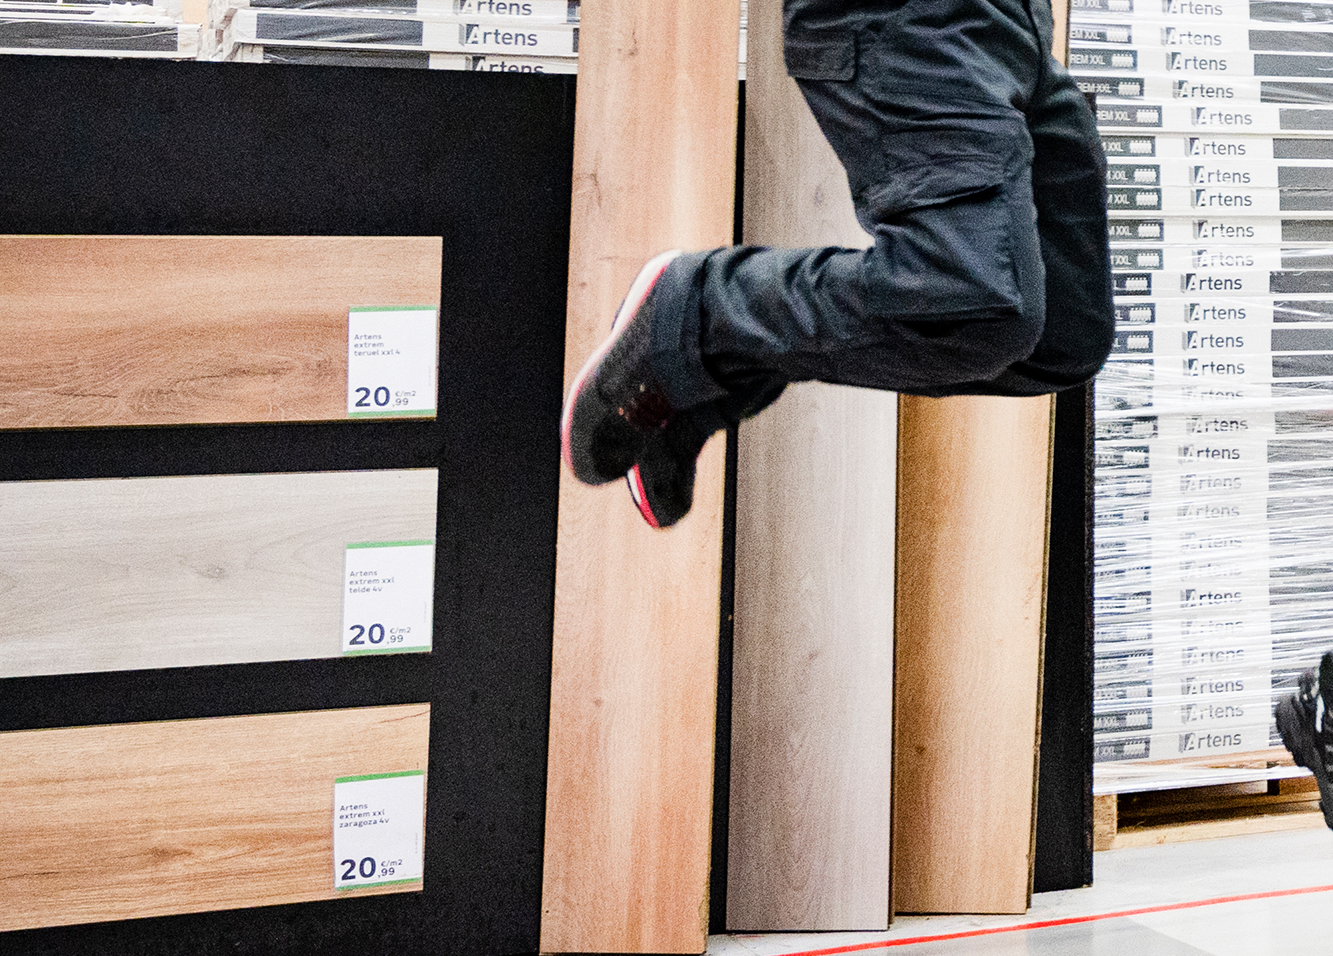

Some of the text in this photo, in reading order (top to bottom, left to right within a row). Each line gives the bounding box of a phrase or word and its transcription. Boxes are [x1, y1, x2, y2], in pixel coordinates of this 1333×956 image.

[466, 24, 538, 46] Artens
[1171, 52, 1227, 71] Artens
[1178, 80, 1234, 99] Artens
[1196, 107, 1253, 126] Artens
[1189, 137, 1246, 156] Artens
[1194, 166, 1251, 184] Artens
[1196, 189, 1253, 207] Artens
[1198, 220, 1255, 238] Artens
[1186, 273, 1242, 291] Artens
[1189, 303, 1246, 321] Artens
[1187, 331, 1244, 349] Artens
[1188, 359, 1245, 376] Artens
[355, 386, 390, 407] 20
[349, 623, 385, 645] 20
[1184, 733, 1242, 751] Artens
[339, 811, 371, 820] extrem
[340, 804, 368, 812] Artens
[339, 819, 378, 829] zaragoza
[340, 856, 376, 881] 20
